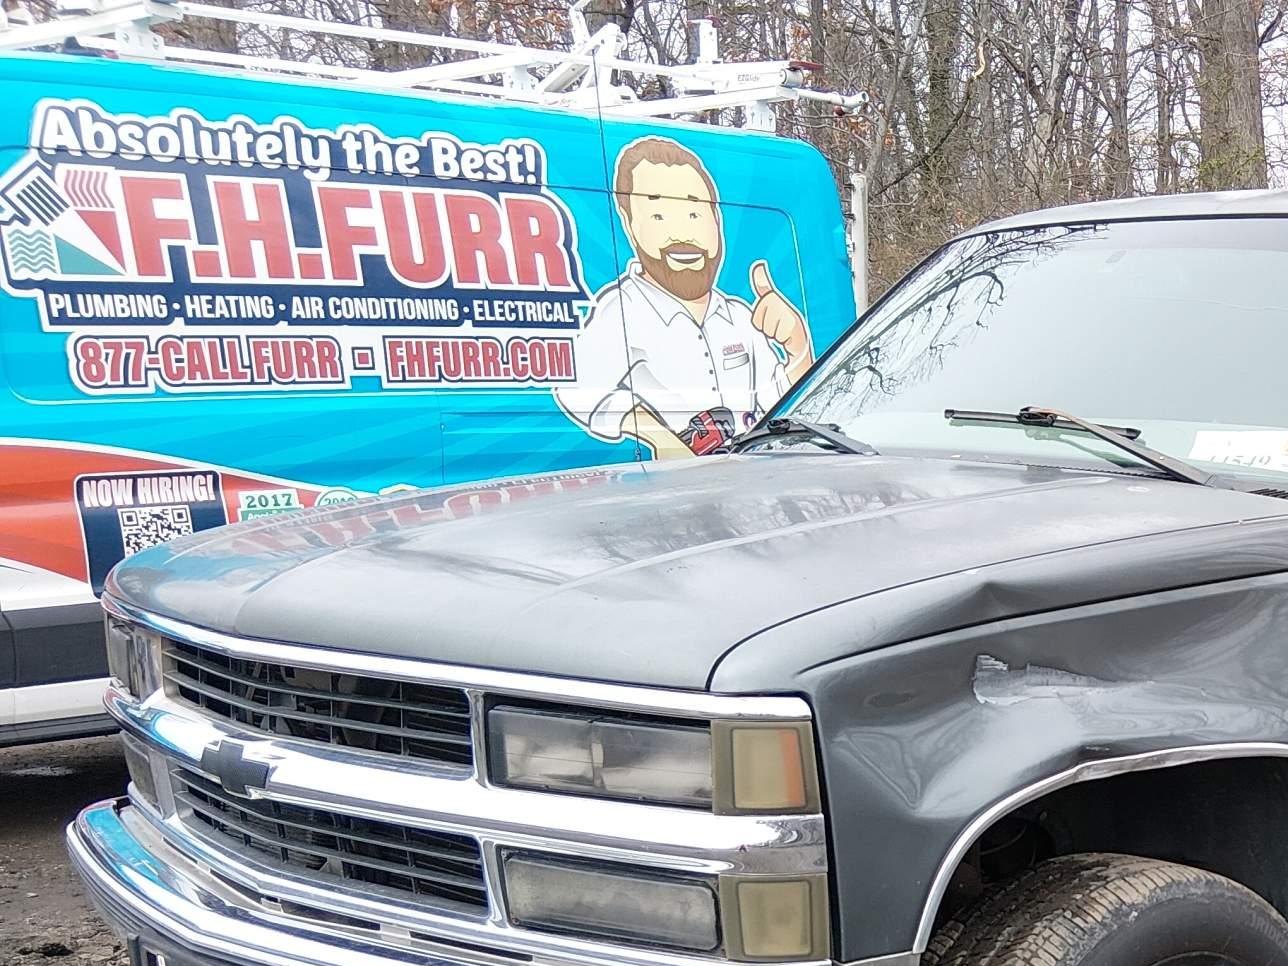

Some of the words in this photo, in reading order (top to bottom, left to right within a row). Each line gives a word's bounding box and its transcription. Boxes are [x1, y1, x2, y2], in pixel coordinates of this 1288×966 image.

[41, 107, 331, 181] Absolutely
[342, 130, 420, 178] the
[431, 137, 537, 185] Best!
[49, 293, 168, 318] PLUMBING
[185, 295, 275, 319] HEATING
[291, 296, 325, 319] AIR
[328, 297, 459, 321] CONDITIONING
[473, 299, 575, 323] ELECTRICAL
[387, 340, 573, 378] FHFURR.COM
[82, 478, 134, 508] NOW
[136, 473, 216, 505] HIRING!
[245, 493, 293, 508] 2017
